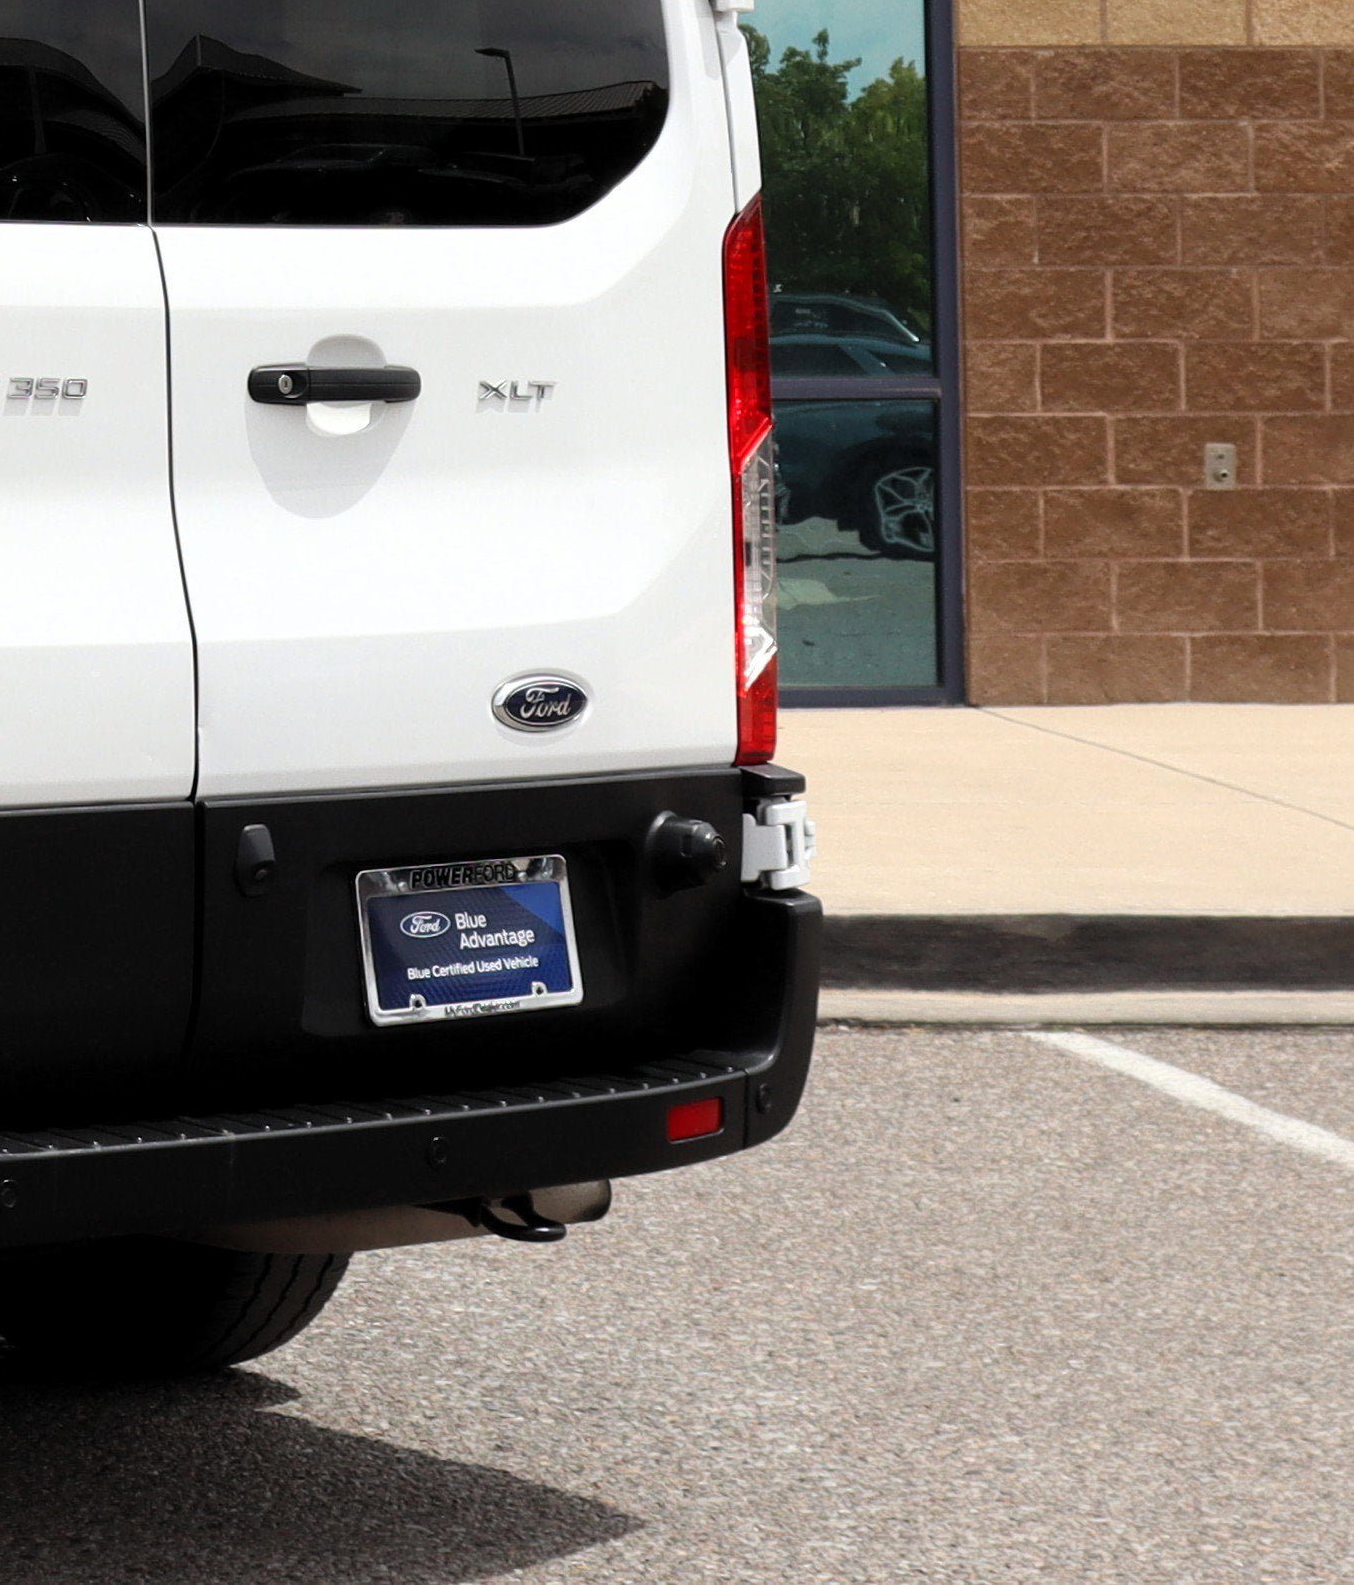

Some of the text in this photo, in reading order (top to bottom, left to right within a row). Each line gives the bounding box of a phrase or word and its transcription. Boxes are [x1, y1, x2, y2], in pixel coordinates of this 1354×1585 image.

[7, 376, 89, 400] 350
[478, 379, 557, 401] XLT
[520, 686, 572, 719] Ford
[409, 864, 517, 889] POWERFORD
[409, 915, 441, 934] Ford
[455, 912, 487, 930] Blue
[460, 928, 536, 950] Advantage
[407, 955, 539, 980] Blue Certified Used Vehicle
